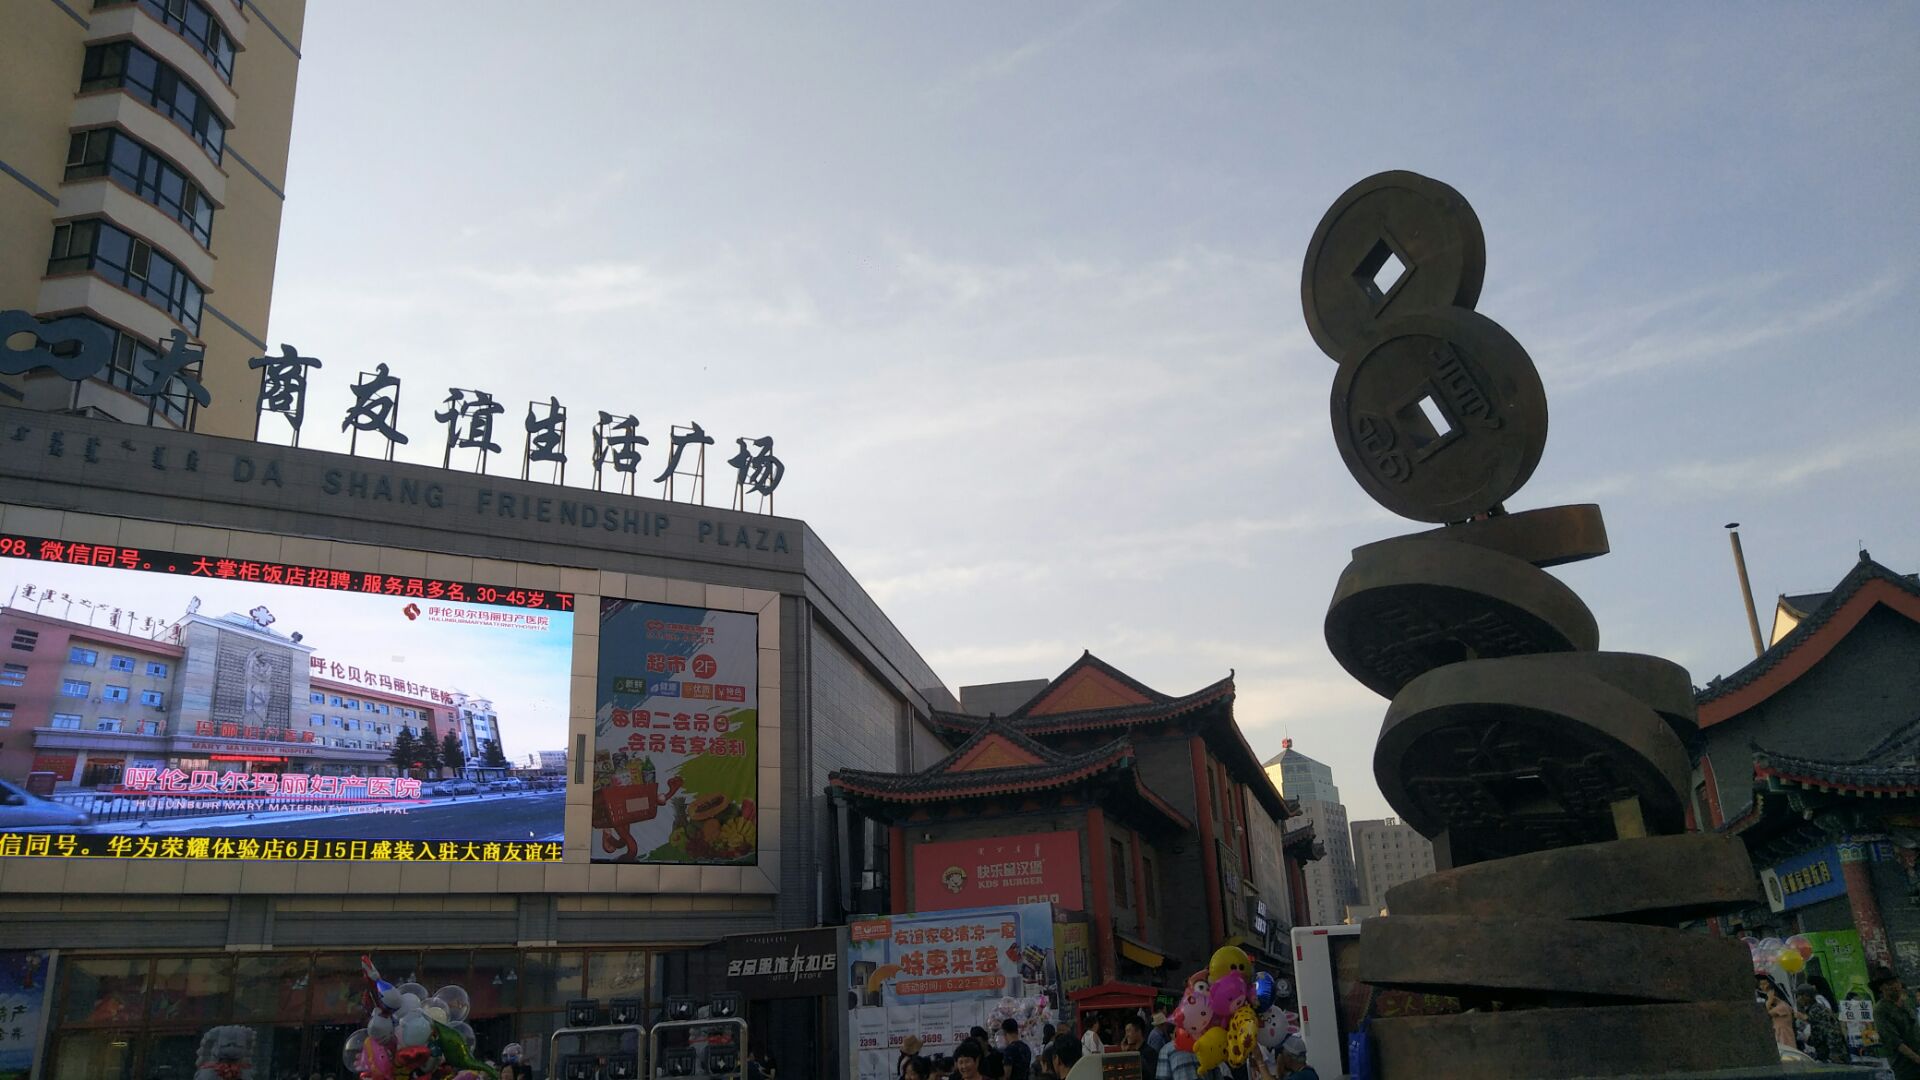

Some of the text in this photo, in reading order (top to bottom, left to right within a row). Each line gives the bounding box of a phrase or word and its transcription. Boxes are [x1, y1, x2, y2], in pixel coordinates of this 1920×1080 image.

[233, 456, 790, 554] DA SHANG FRIENDSHIP PLAZA
[428, 606, 549, 626] 呼伦贝尔玛丽妇产医院
[646, 653, 714, 674] 超市 2F
[310, 656, 453, 704] 呼伦贝尔玛丽妇产医院
[628, 733, 746, 756] 会员专享福利
[125, 767, 423, 799] 呼伦贝尔玛丽妇产医院
[224, 802, 263, 811] MARY
[268, 803, 343, 813] MATERNITY
[348, 805, 410, 815] HOSPITAL
